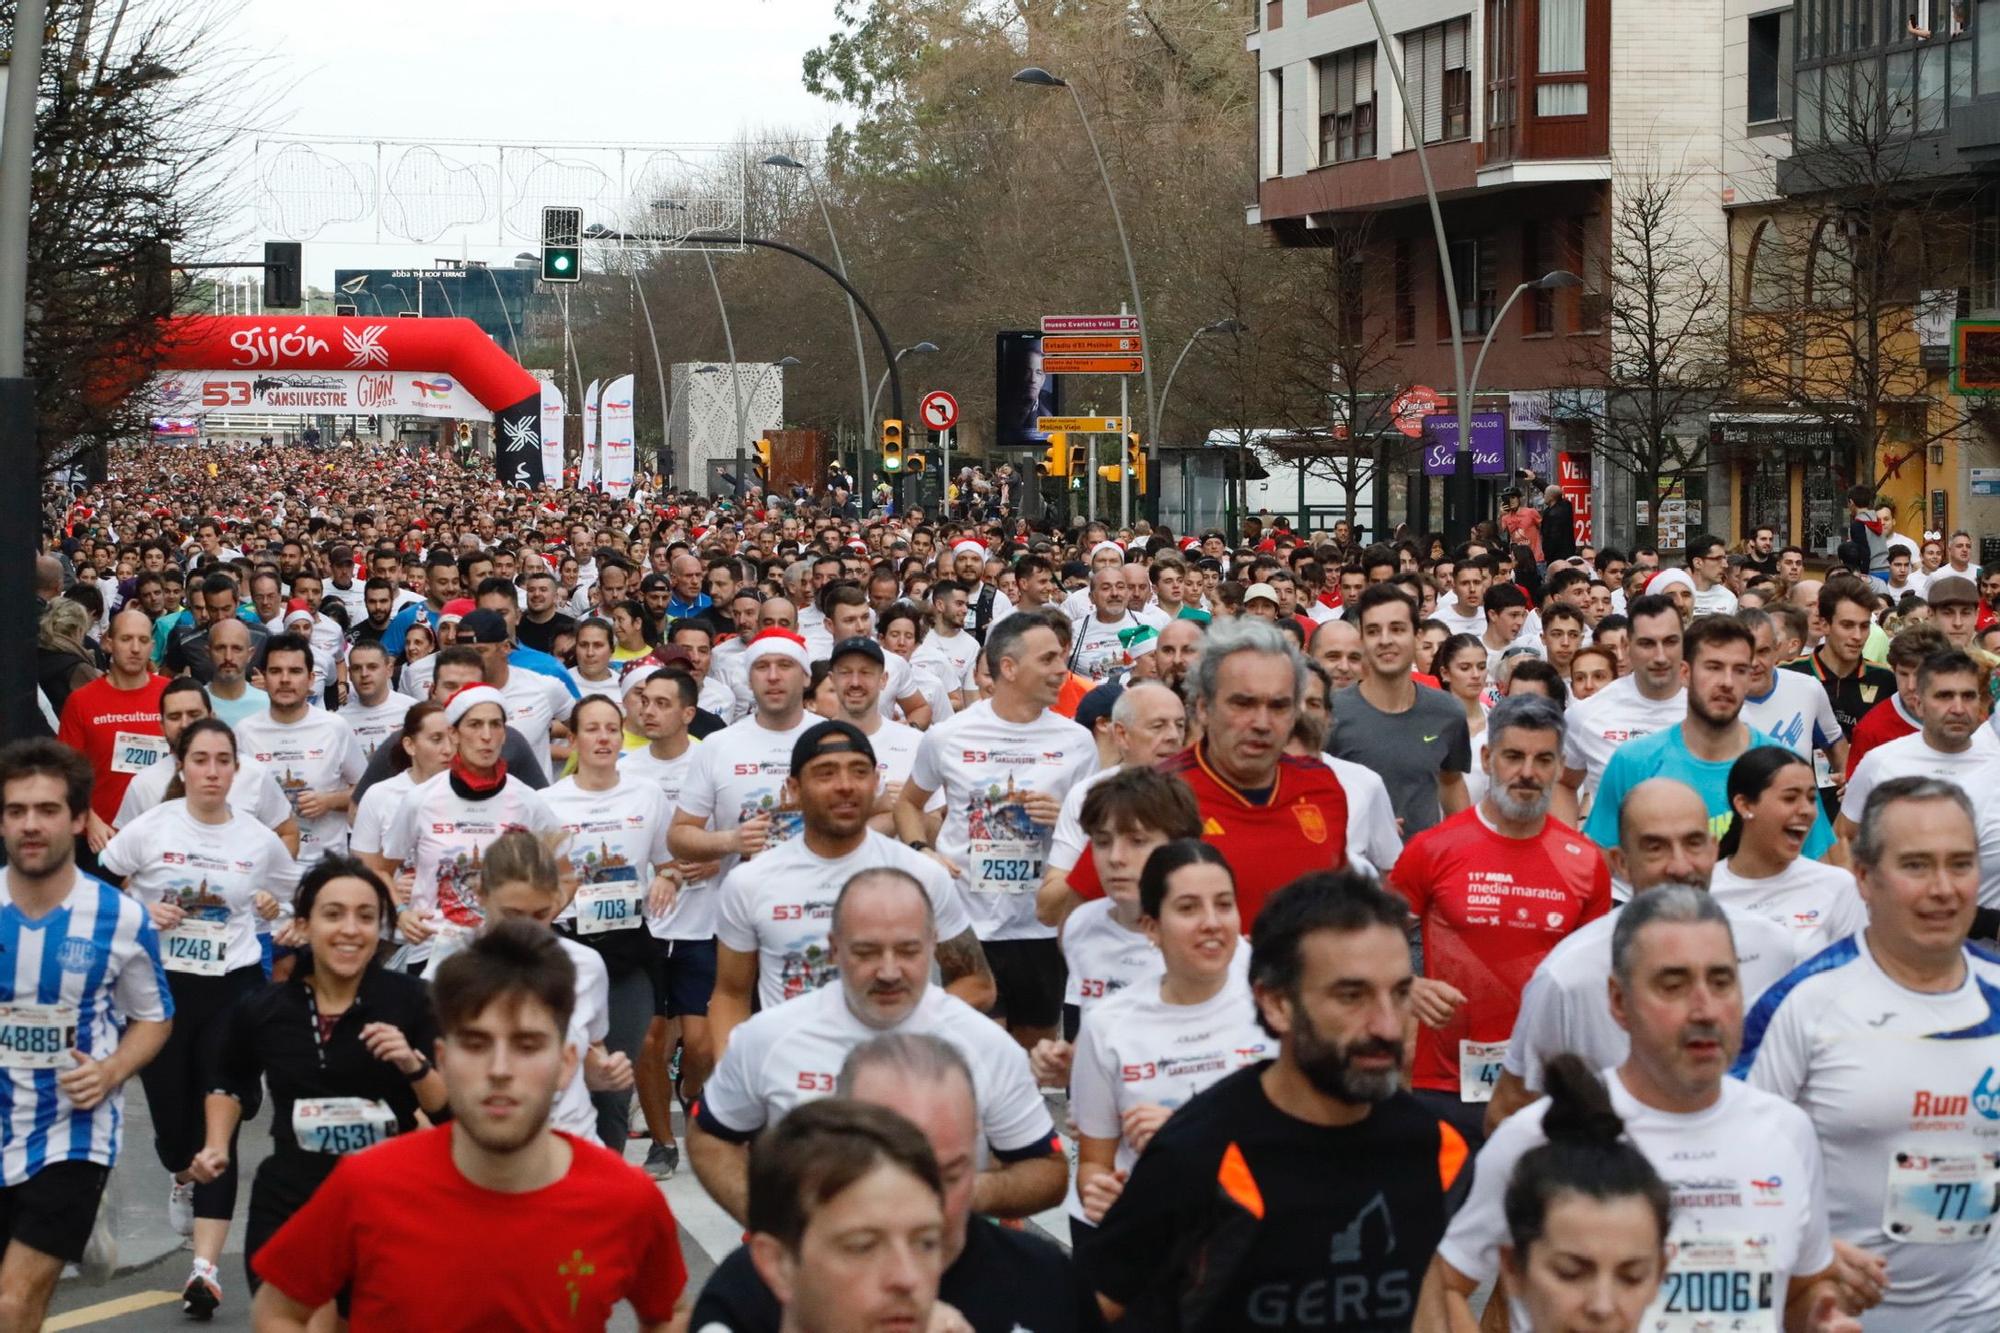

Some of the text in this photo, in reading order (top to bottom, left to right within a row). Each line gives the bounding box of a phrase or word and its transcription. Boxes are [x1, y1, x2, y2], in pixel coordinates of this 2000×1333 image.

[391, 270, 411, 278] abba
[1068, 320, 1097, 328] Evaristo
[230, 324, 330, 367] gijón
[202, 381, 347, 407] 53 SANSILVESTRE
[376, 398, 398, 409] 2022
[1428, 444, 1500, 467] Saina
[93, 712, 162, 725] entrecultura
[1603, 731, 1628, 741] 53
[125, 747, 157, 766] 2210
[256, 752, 272, 762] 53
[962, 750, 987, 763] 53
[734, 763, 759, 776] 53
[432, 823, 454, 834] 53
[163, 852, 186, 865] 53
[983, 859, 1029, 881] 2532
[1485, 872, 1514, 883] MBA
[1467, 894, 1501, 905] GIJÓN
[1468, 882, 1566, 902] media maratón
[594, 899, 626, 921] 703
[772, 905, 802, 920] 53
[169, 936, 212, 961] 1248
[1080, 977, 1105, 998] 53
[0, 1025, 61, 1053] 4889
[797, 1071, 834, 1092] 53
[1121, 1062, 1157, 1082] 53
[1913, 1090, 1969, 1117] Run
[316, 1122, 376, 1154] 2631
[1935, 1183, 1972, 1221] 77
[1248, 1269, 1412, 1326] GERS
[1664, 1271, 1750, 1313] 2006
